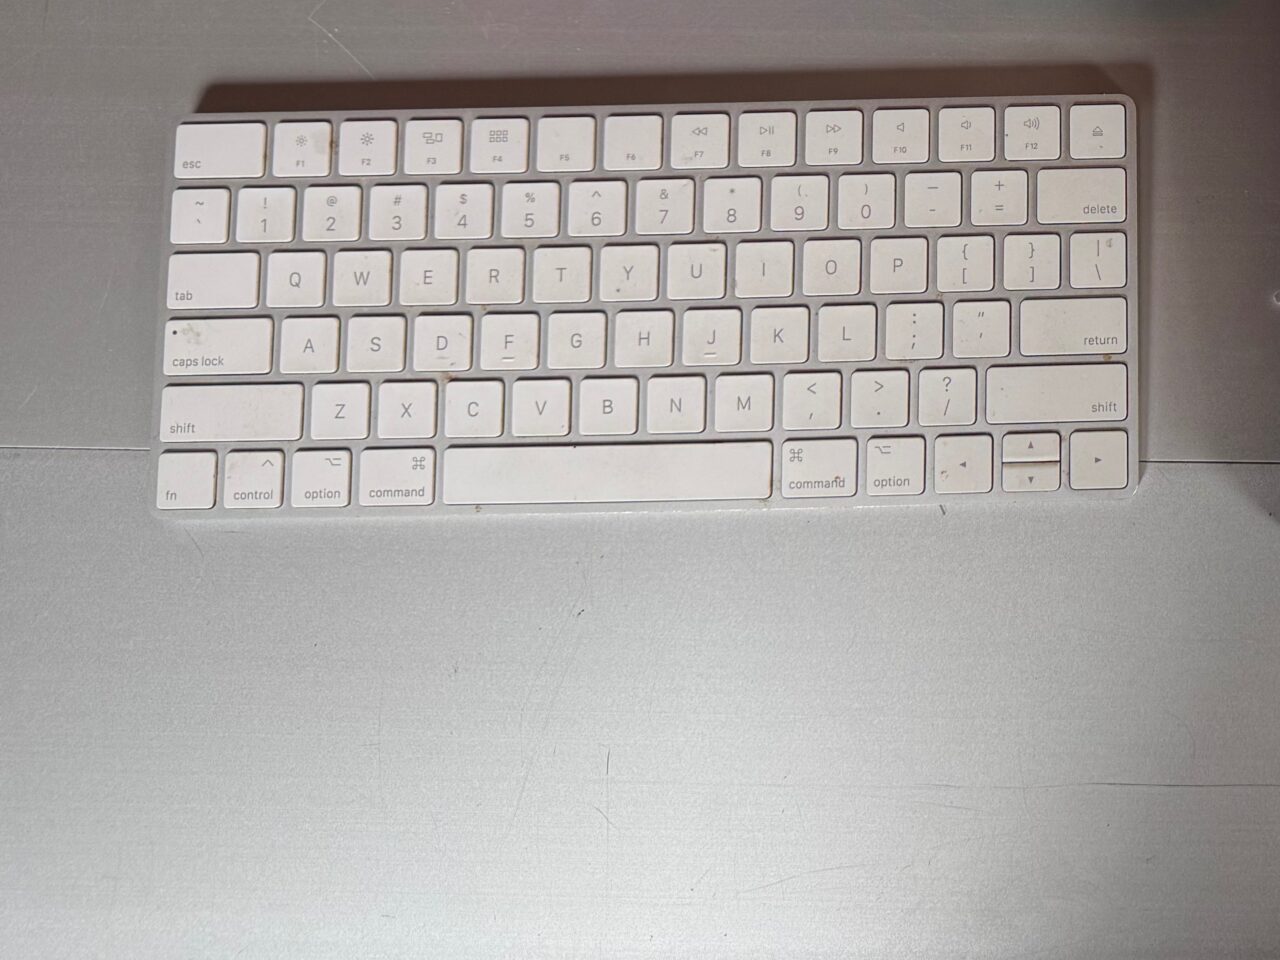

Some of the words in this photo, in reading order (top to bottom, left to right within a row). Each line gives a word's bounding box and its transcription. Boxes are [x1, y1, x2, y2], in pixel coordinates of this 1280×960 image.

[760, 149, 772, 158] F8
[828, 147, 839, 155] F9
[893, 146, 907, 154] F10
[960, 144, 973, 152] F11
[1025, 142, 1039, 150] F12
[427, 157, 437, 165] F3
[492, 155, 503, 163] F4
[626, 153, 636, 161] F6
[694, 150, 704, 158] F7
[182, 160, 201, 169] esc
[295, 160, 306, 168] F1
[726, 208, 737, 224] 8
[794, 206, 805, 222] 9
[861, 204, 872, 220] 0
[1083, 203, 1118, 216] delete
[326, 217, 337, 232] 2
[391, 216, 403, 231] 3
[457, 214, 468, 229] 4
[524, 213, 535, 228] 5
[591, 211, 602, 226] 6
[659, 210, 670, 225] 7
[623, 265, 634, 280] Y
[691, 263, 702, 279] U
[825, 260, 837, 276] O
[893, 258, 904, 273] P
[289, 272, 301, 288] Q
[353, 271, 370, 286] W
[424, 270, 434, 285] E
[489, 269, 500, 284] R
[556, 267, 567, 282] T
[175, 291, 193, 301] tab
[570, 333, 583, 349] G
[638, 331, 650, 346] H
[707, 330, 716, 345] J
[773, 328, 784, 344] K
[842, 326, 852, 342] L
[1083, 335, 1118, 346] return
[303, 338, 315, 353] A
[370, 337, 382, 352] S
[436, 336, 449, 351] D
[504, 334, 514, 350] F
[172, 358, 199, 368] caps
[201, 356, 224, 367] lock
[401, 403, 412, 418] X
[467, 402, 480, 417] C
[535, 400, 547, 416] V
[602, 399, 614, 414] B
[670, 398, 682, 413] N
[737, 396, 752, 411] M
[1091, 401, 1118, 413] shift
[334, 404, 346, 419] Z
[169, 423, 195, 434] shift
[788, 477, 846, 490] command
[873, 475, 910, 489] option
[165, 490, 177, 501] fn
[233, 489, 273, 501] control
[304, 489, 341, 501] option
[368, 487, 425, 499] command
